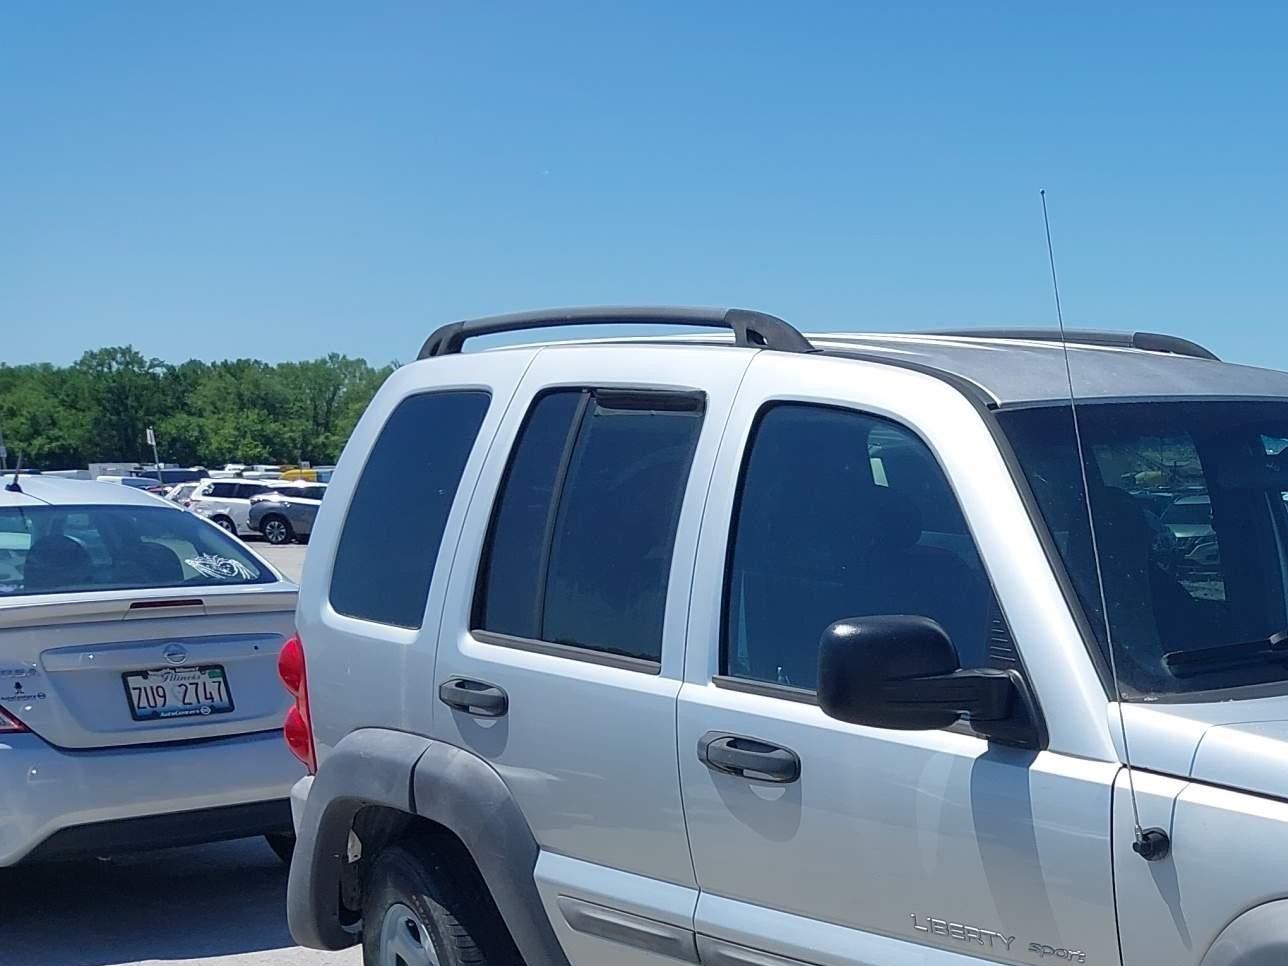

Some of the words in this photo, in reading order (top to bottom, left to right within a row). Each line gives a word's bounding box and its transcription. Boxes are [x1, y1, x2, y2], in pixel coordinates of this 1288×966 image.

[132, 685, 168, 709] ZU9
[178, 681, 223, 706] 2747
[910, 913, 1016, 950] LIBERTY
[1027, 942, 1088, 963] sport
